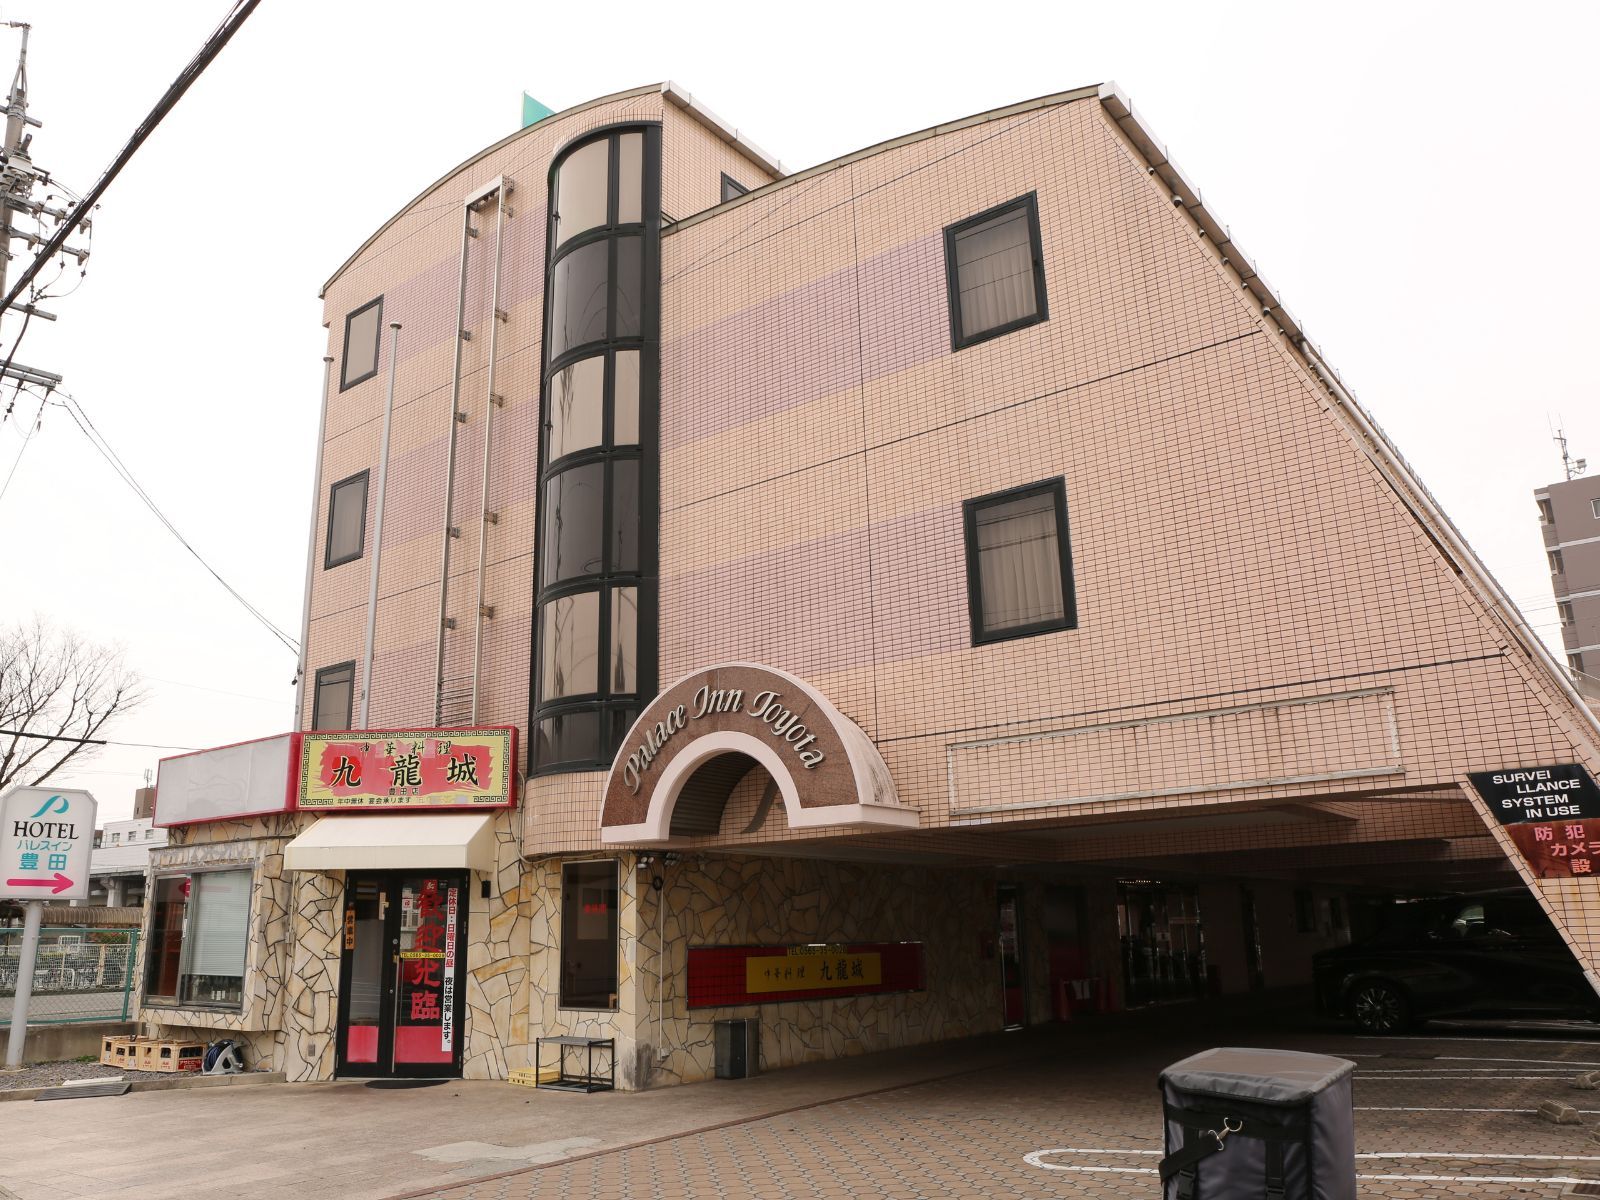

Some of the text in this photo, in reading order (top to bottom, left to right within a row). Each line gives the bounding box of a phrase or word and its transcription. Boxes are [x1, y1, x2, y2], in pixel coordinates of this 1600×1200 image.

[360, 741, 452, 755] 中華料理
[624, 685, 825, 796] Palace Inn Toyota
[331, 753, 479, 787] 九龍城
[1493, 770, 1551, 784] SURVEI
[1516, 779, 1581, 793] LLANCE
[1502, 794, 1569, 808] SYSTEM
[1526, 805, 1581, 818] IN USE
[13, 820, 79, 839] HOTEL
[1534, 825, 1586, 841] 防犯
[19, 852, 67, 870] 豊田
[1570, 858, 1592, 873] 設
[820, 958, 865, 981] 九龍城
